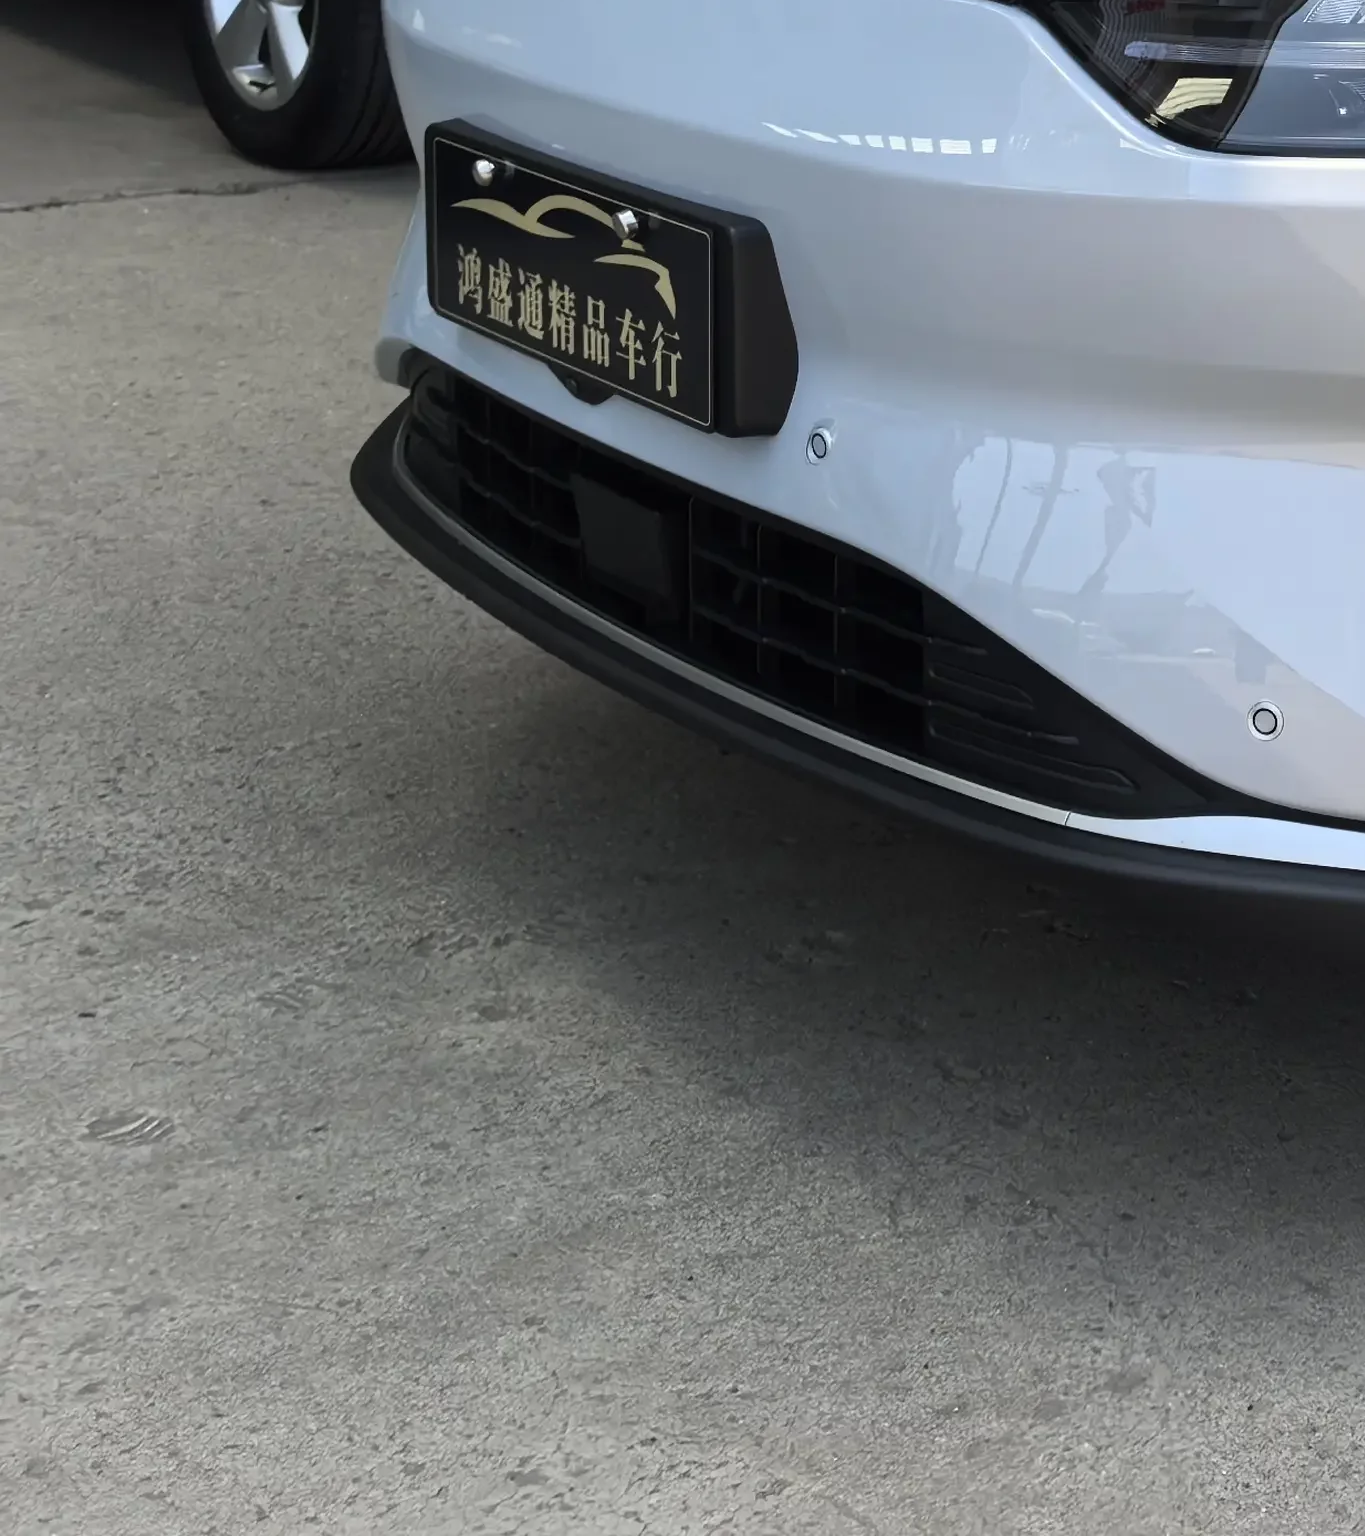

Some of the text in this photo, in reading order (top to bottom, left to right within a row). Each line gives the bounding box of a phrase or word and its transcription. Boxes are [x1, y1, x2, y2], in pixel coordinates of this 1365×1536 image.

[457, 243, 683, 399] 鸿盛通精品车行
